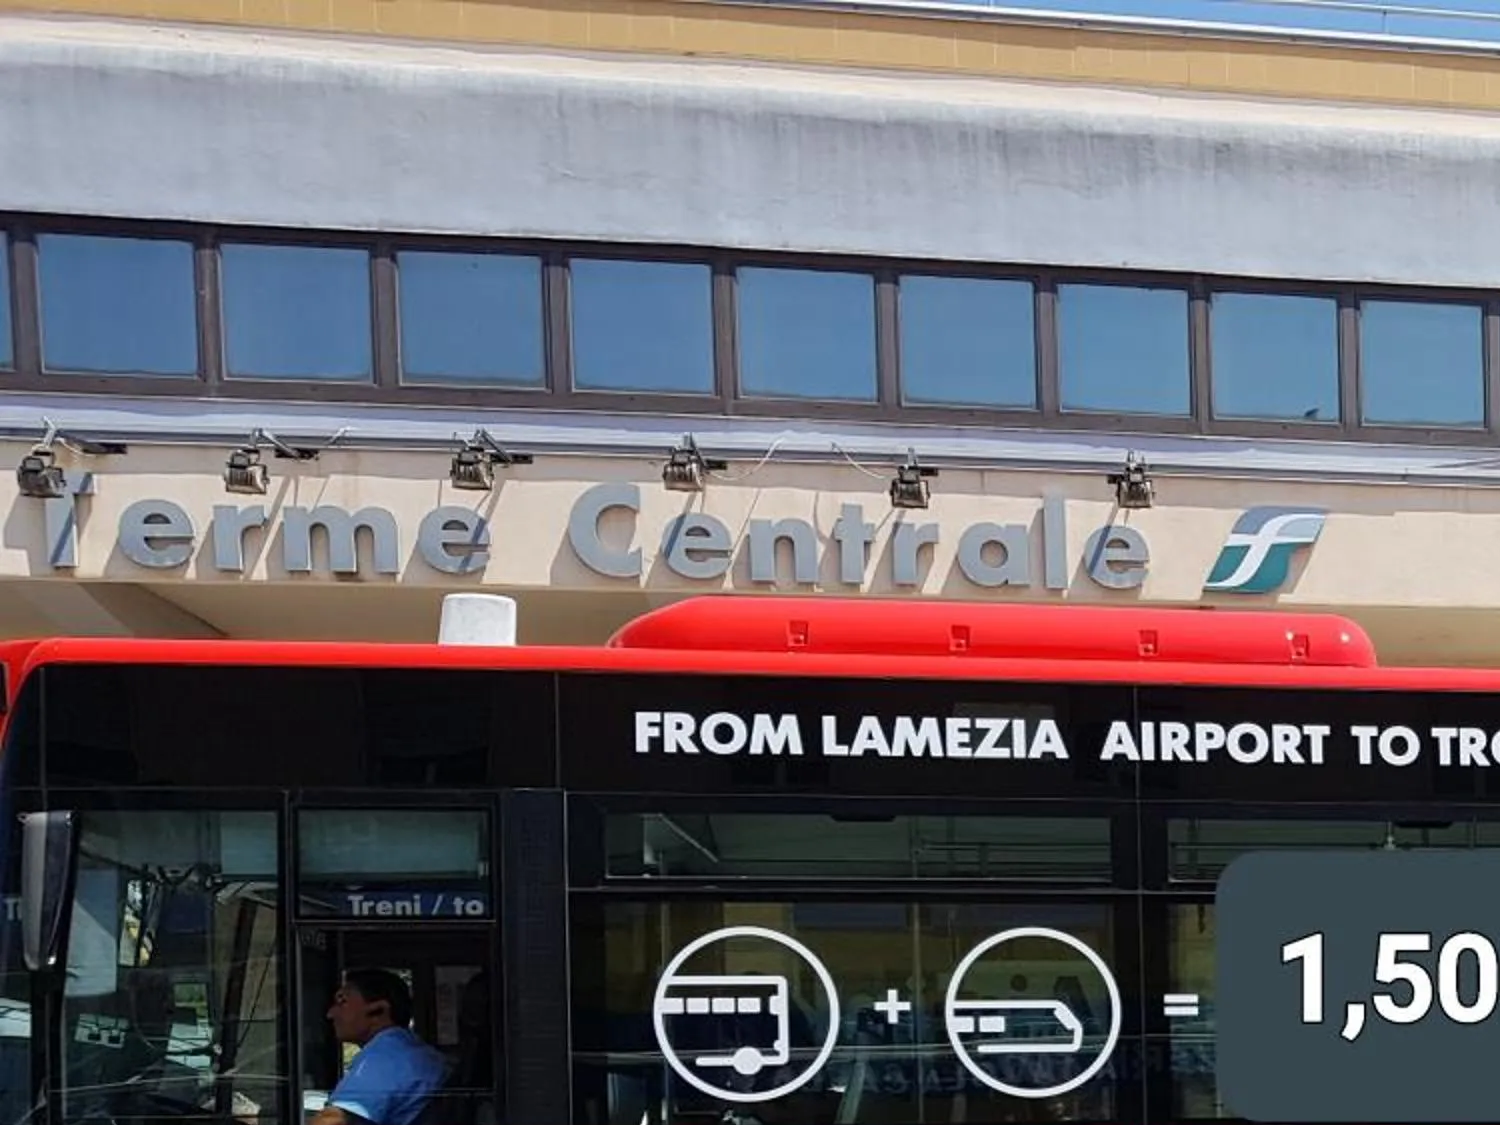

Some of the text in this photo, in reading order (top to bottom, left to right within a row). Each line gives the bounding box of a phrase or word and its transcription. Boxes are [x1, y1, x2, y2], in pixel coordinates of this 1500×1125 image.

[44, 471, 1150, 591] Terme Centrale
[634, 711, 804, 755] FROM
[821, 715, 1070, 760] LAMEZIA
[1099, 720, 1331, 764] AIRPORT
[1350, 725, 1422, 767] TO
[347, 895, 422, 916] Treni
[453, 897, 485, 916] to
